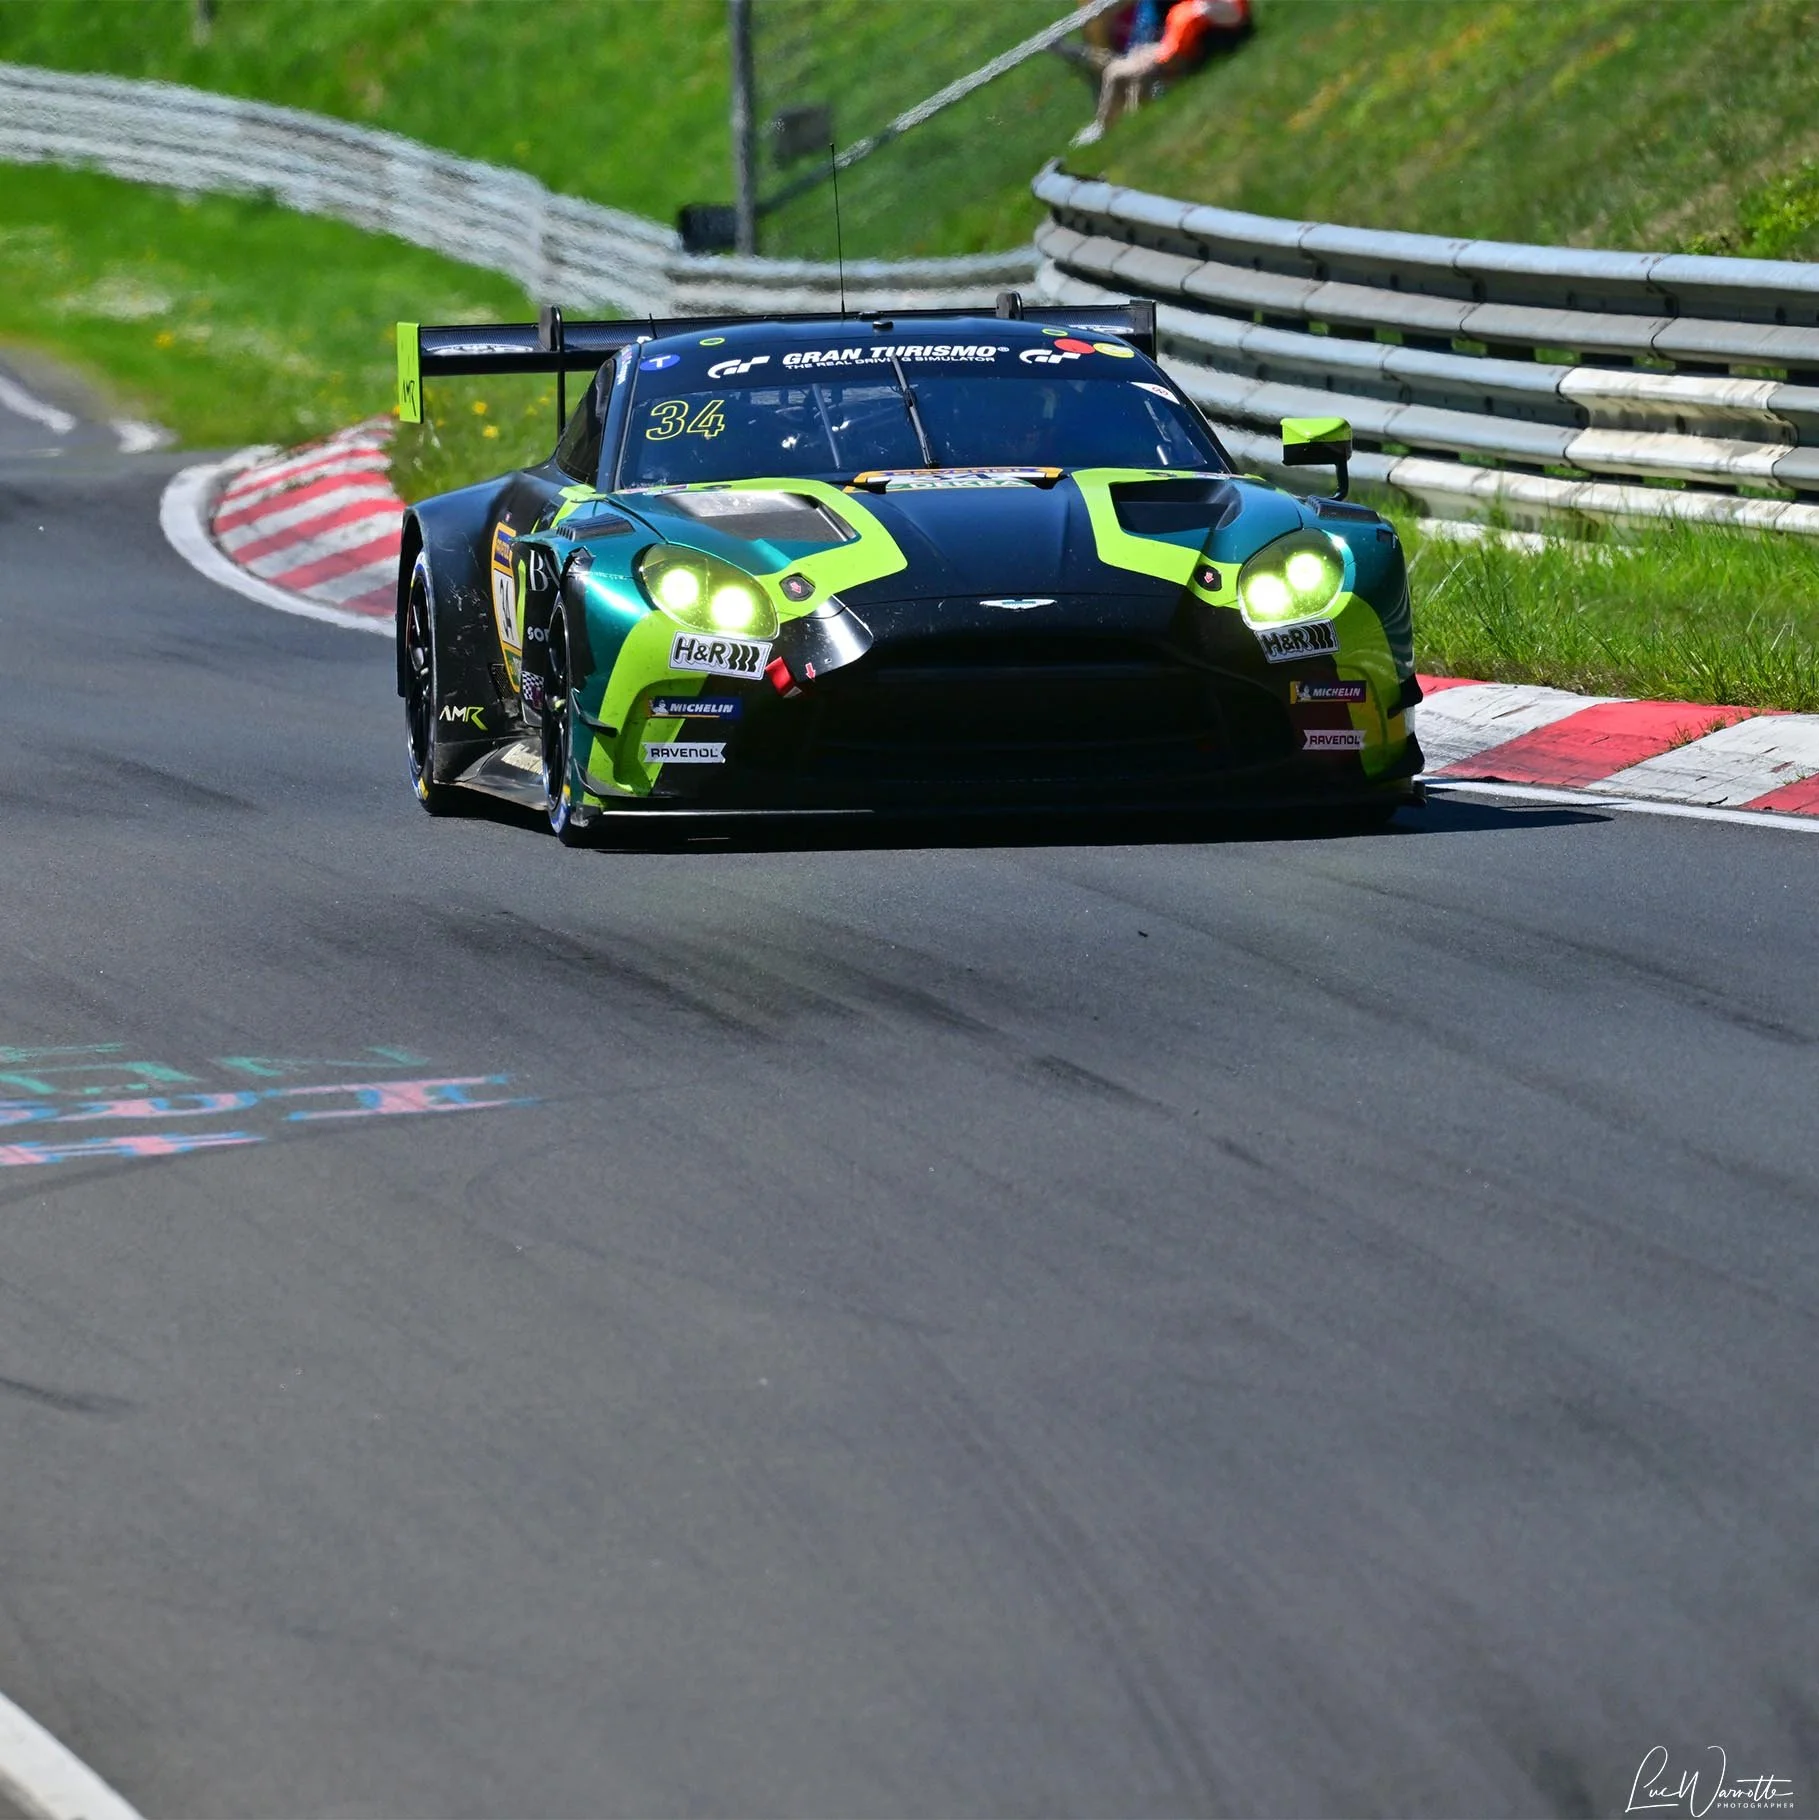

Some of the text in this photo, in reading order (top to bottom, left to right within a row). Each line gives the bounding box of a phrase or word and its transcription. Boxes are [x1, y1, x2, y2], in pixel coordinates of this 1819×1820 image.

[648, 355, 672, 369] T
[782, 347, 863, 366] GRAN
[784, 363, 813, 371] THE
[855, 357, 911, 365] DRIVIG
[645, 399, 726, 441] 34
[1263, 628, 1310, 655] H&R
[674, 637, 728, 666] H&R
[1312, 687, 1361, 697] MICHELIN
[669, 703, 734, 713] MICHELIN
[439, 705, 489, 731] AMR
[1309, 735, 1360, 745] RAVENOL
[651, 747, 719, 758] RAVENOL
